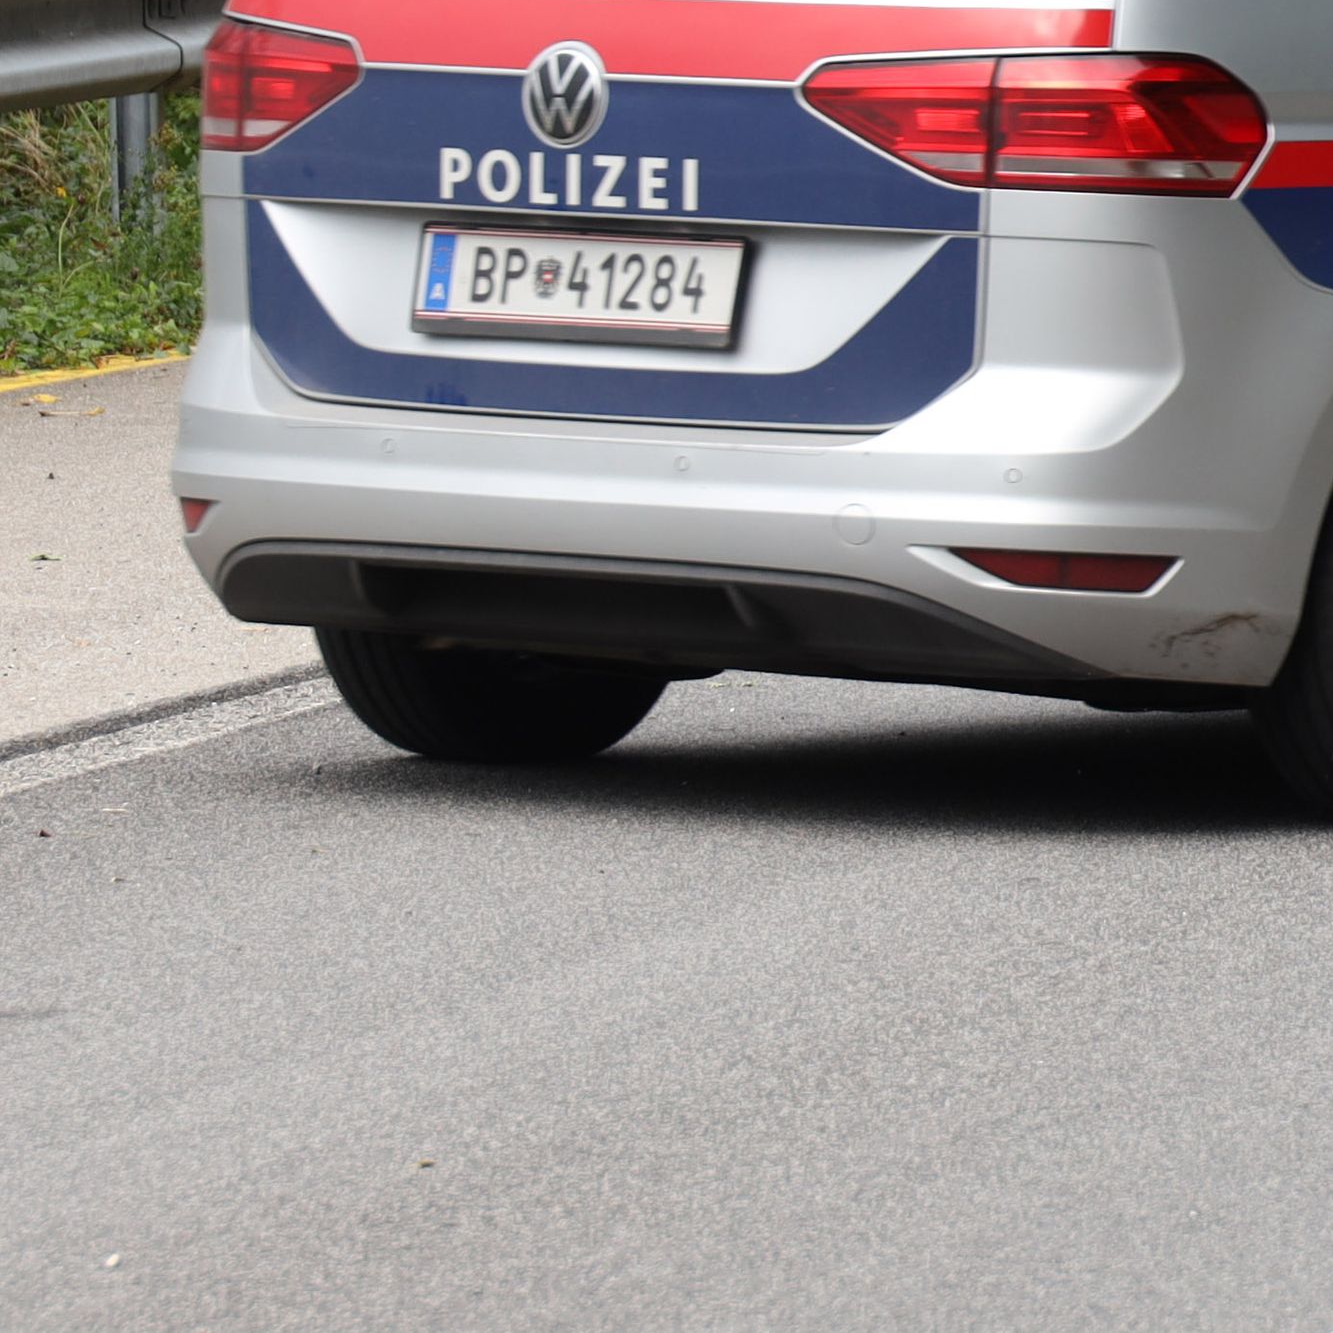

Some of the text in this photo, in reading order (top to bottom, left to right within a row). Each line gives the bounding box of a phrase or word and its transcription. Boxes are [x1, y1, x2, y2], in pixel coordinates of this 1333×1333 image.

[526, 46, 604, 144] VW
[439, 146, 699, 212] POLIZEI
[428, 282, 446, 300] A
[470, 245, 706, 315] BP 41284
